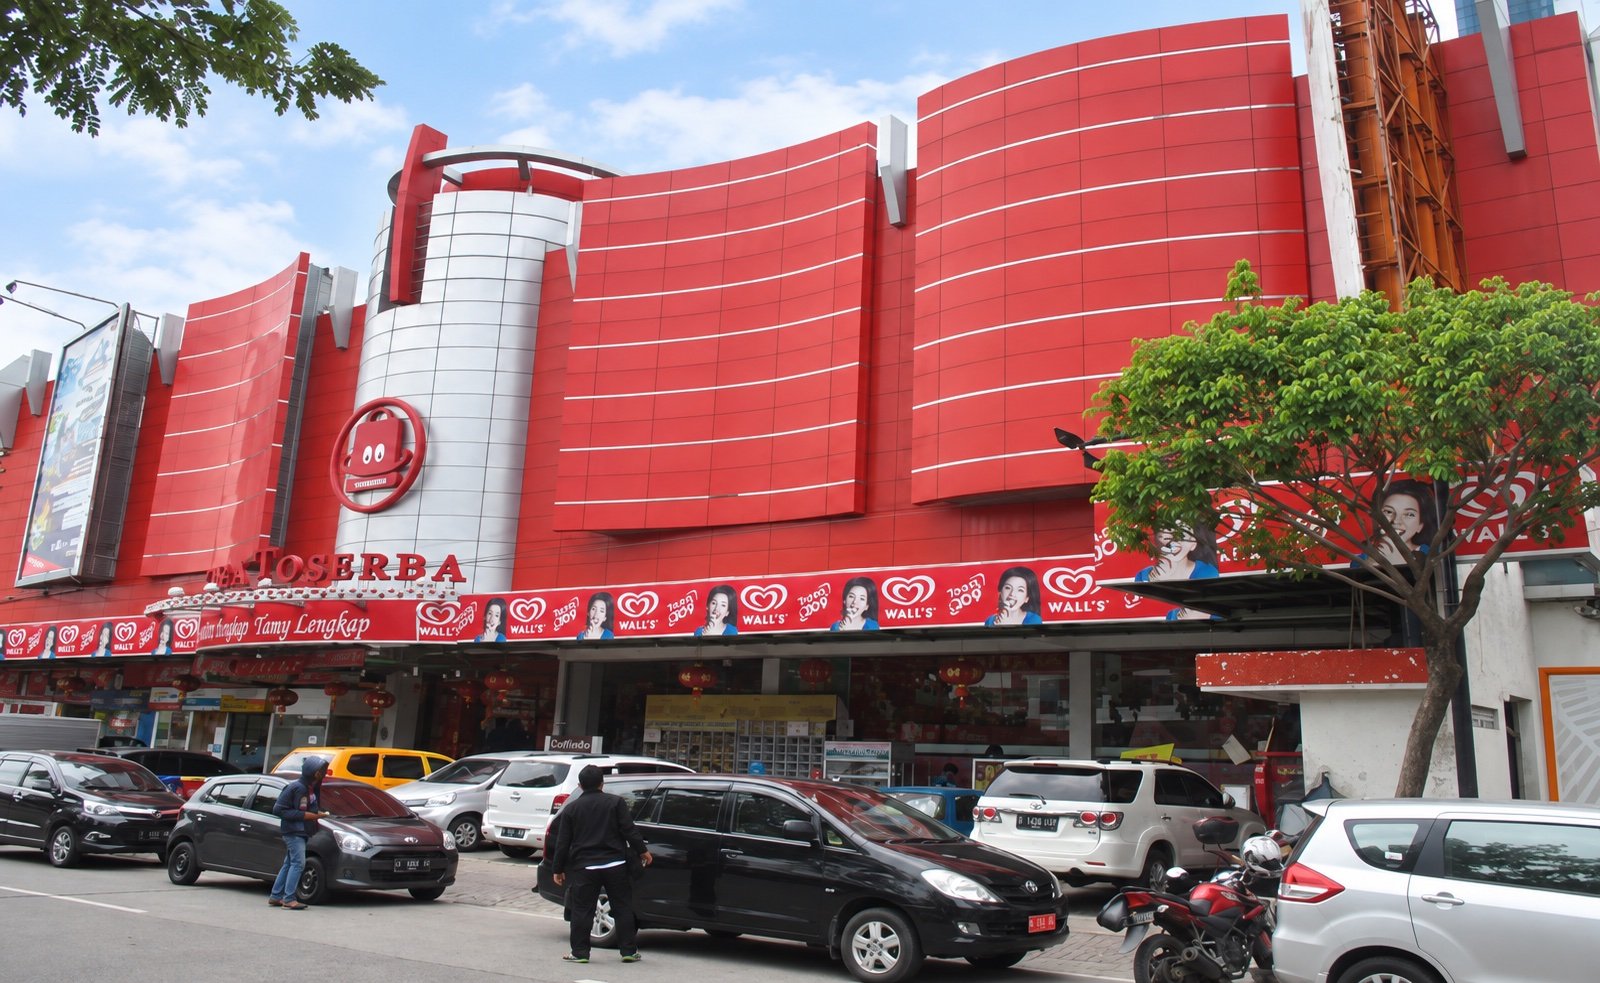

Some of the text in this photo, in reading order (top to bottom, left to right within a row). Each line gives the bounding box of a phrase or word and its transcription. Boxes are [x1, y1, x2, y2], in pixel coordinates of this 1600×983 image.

[256, 548, 467, 583] TOSERBA
[1048, 600, 1106, 613] WALL'S
[885, 607, 934, 619] WALL'S
[293, 610, 370, 641] Lengkap
[618, 620, 656, 630] WALL'S
[742, 614, 786, 625] WALL'S
[510, 624, 544, 634] WALL'S
